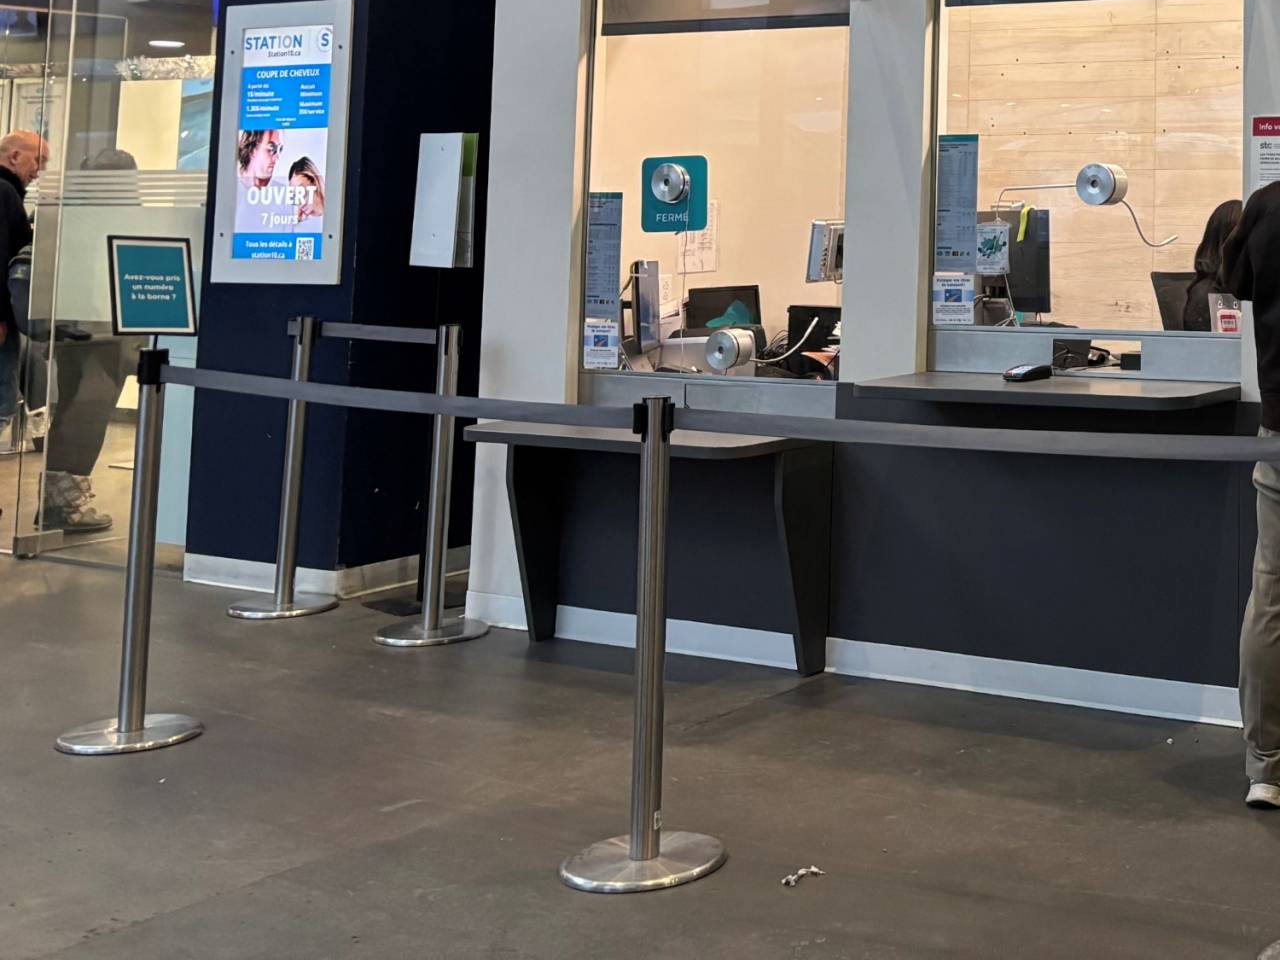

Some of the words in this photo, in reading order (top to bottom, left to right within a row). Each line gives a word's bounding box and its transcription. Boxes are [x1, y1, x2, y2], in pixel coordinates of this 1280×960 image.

[256, 70, 279, 79] COUPE
[279, 69, 288, 78] DE
[289, 68, 320, 77] CHEVEUX
[1259, 122, 1272, 130] Info
[247, 185, 317, 205] OUVERT
[261, 212, 268, 225] 7
[269, 212, 298, 228] jours
[124, 273, 164, 281] Avez-vous
[165, 274, 181, 282] pris
[138, 292, 145, 300] la
[147, 292, 170, 300] borne
